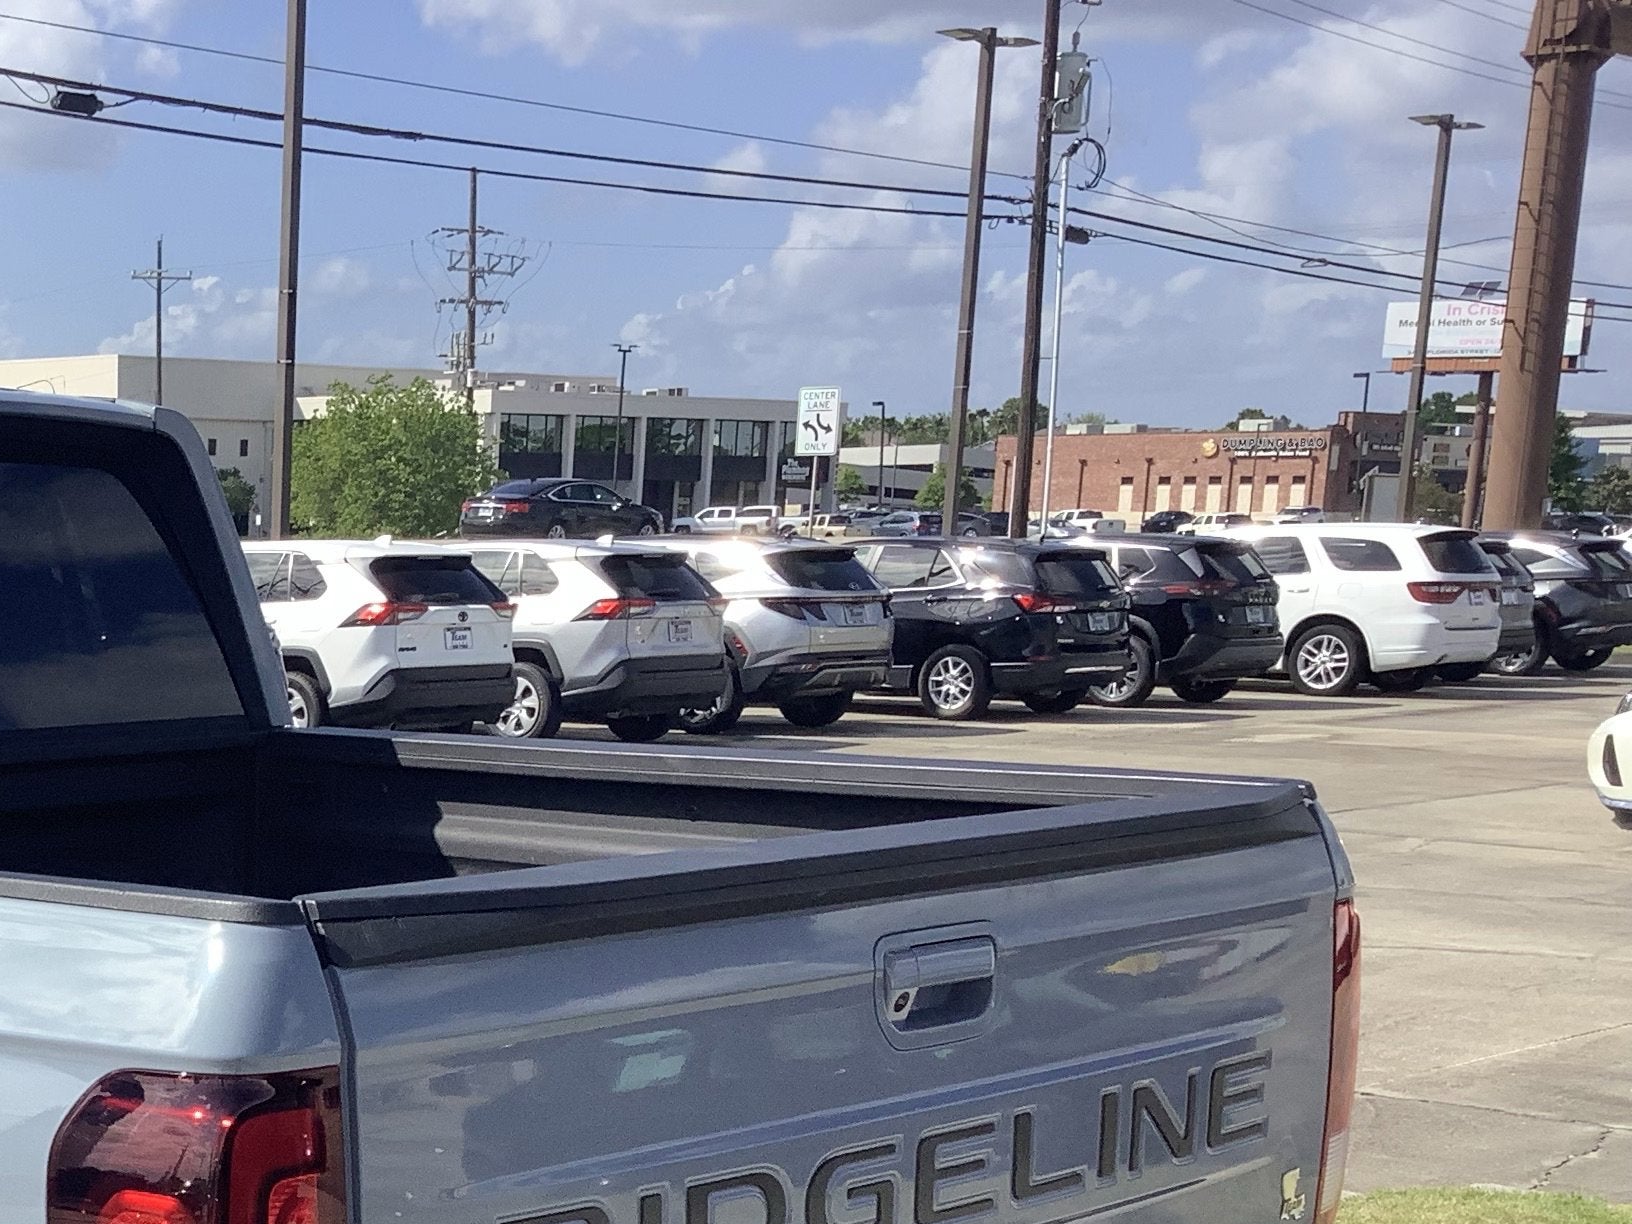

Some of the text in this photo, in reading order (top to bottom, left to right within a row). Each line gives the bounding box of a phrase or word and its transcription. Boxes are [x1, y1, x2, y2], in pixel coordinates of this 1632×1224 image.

[1447, 303, 1505, 316] In Crisi
[1437, 319, 1473, 327] Health
[804, 391, 837, 401] CENTER
[808, 400, 831, 409] LANE
[804, 443, 827, 451] ONLY
[1221, 437, 1325, 449] DUMPLING & BAO
